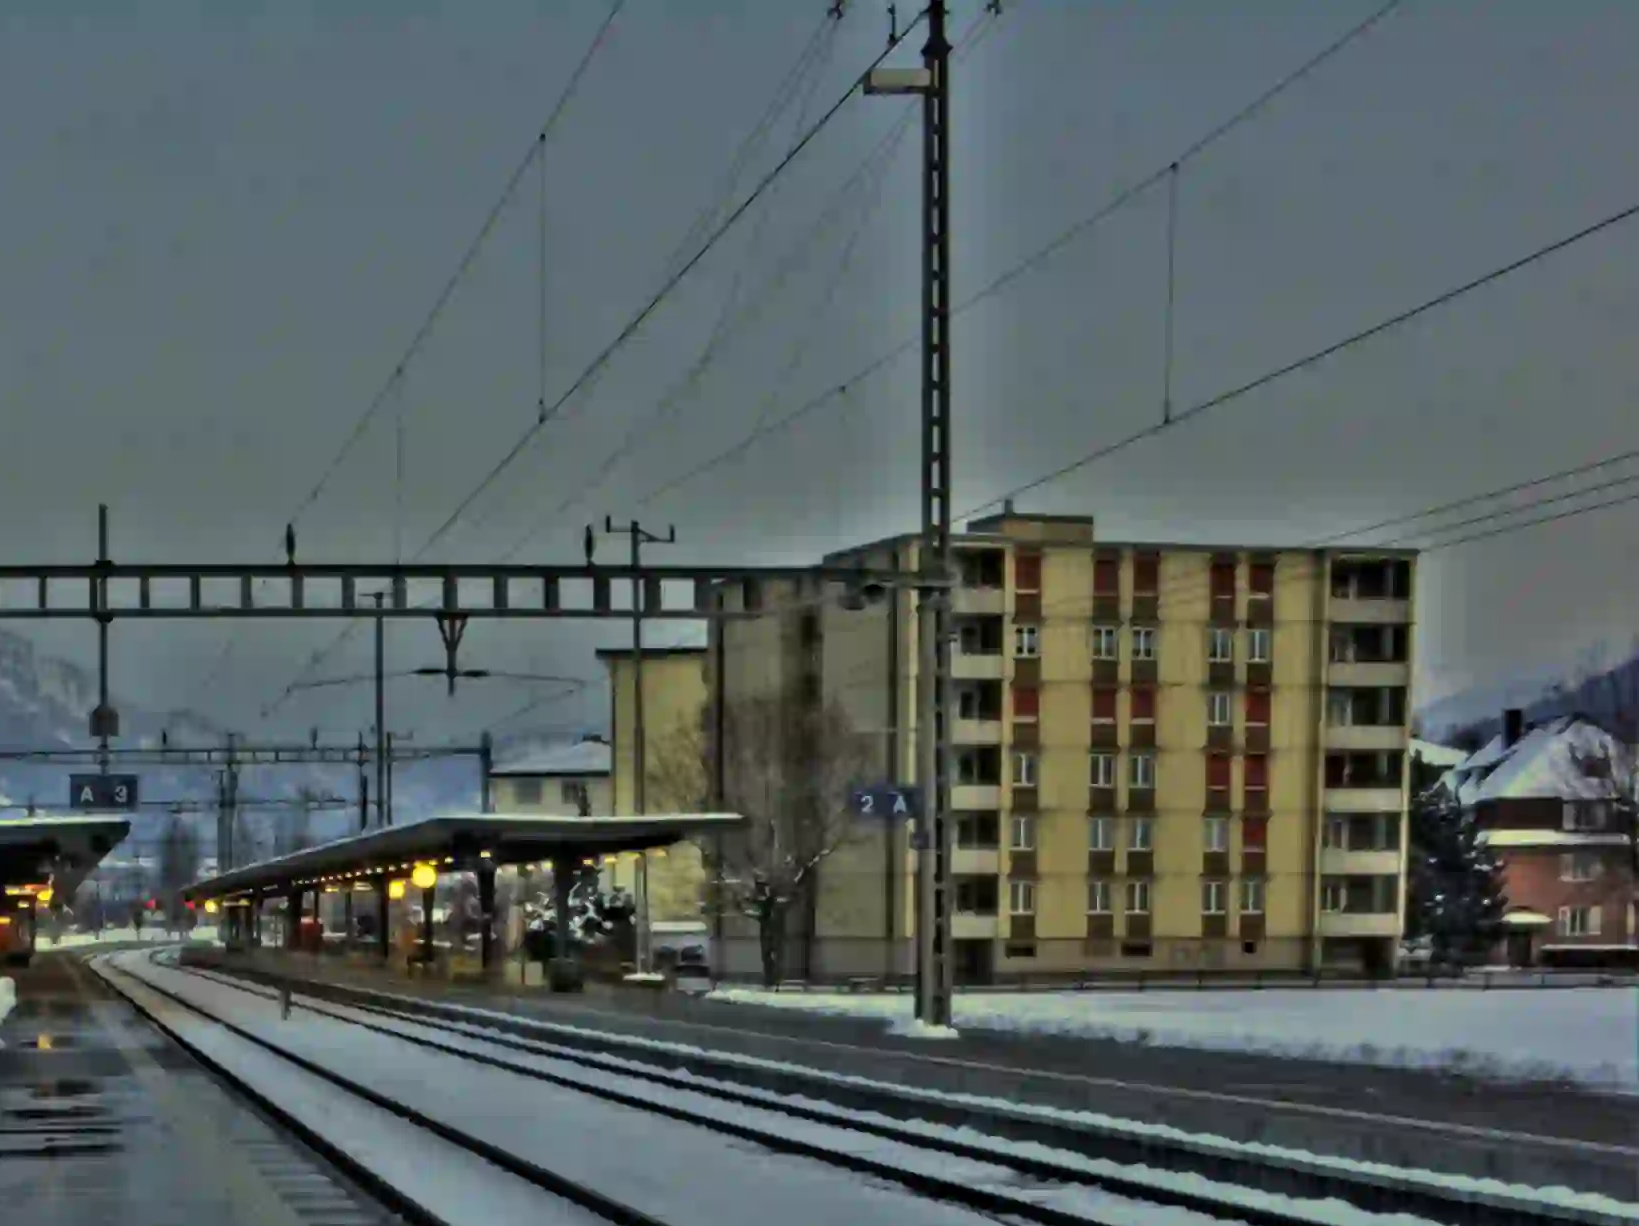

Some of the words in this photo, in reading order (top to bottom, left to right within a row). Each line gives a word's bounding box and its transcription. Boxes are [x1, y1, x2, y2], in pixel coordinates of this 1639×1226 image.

[81, 785, 94, 803] A
[860, 795, 874, 814] 2
[893, 795, 907, 814] A
